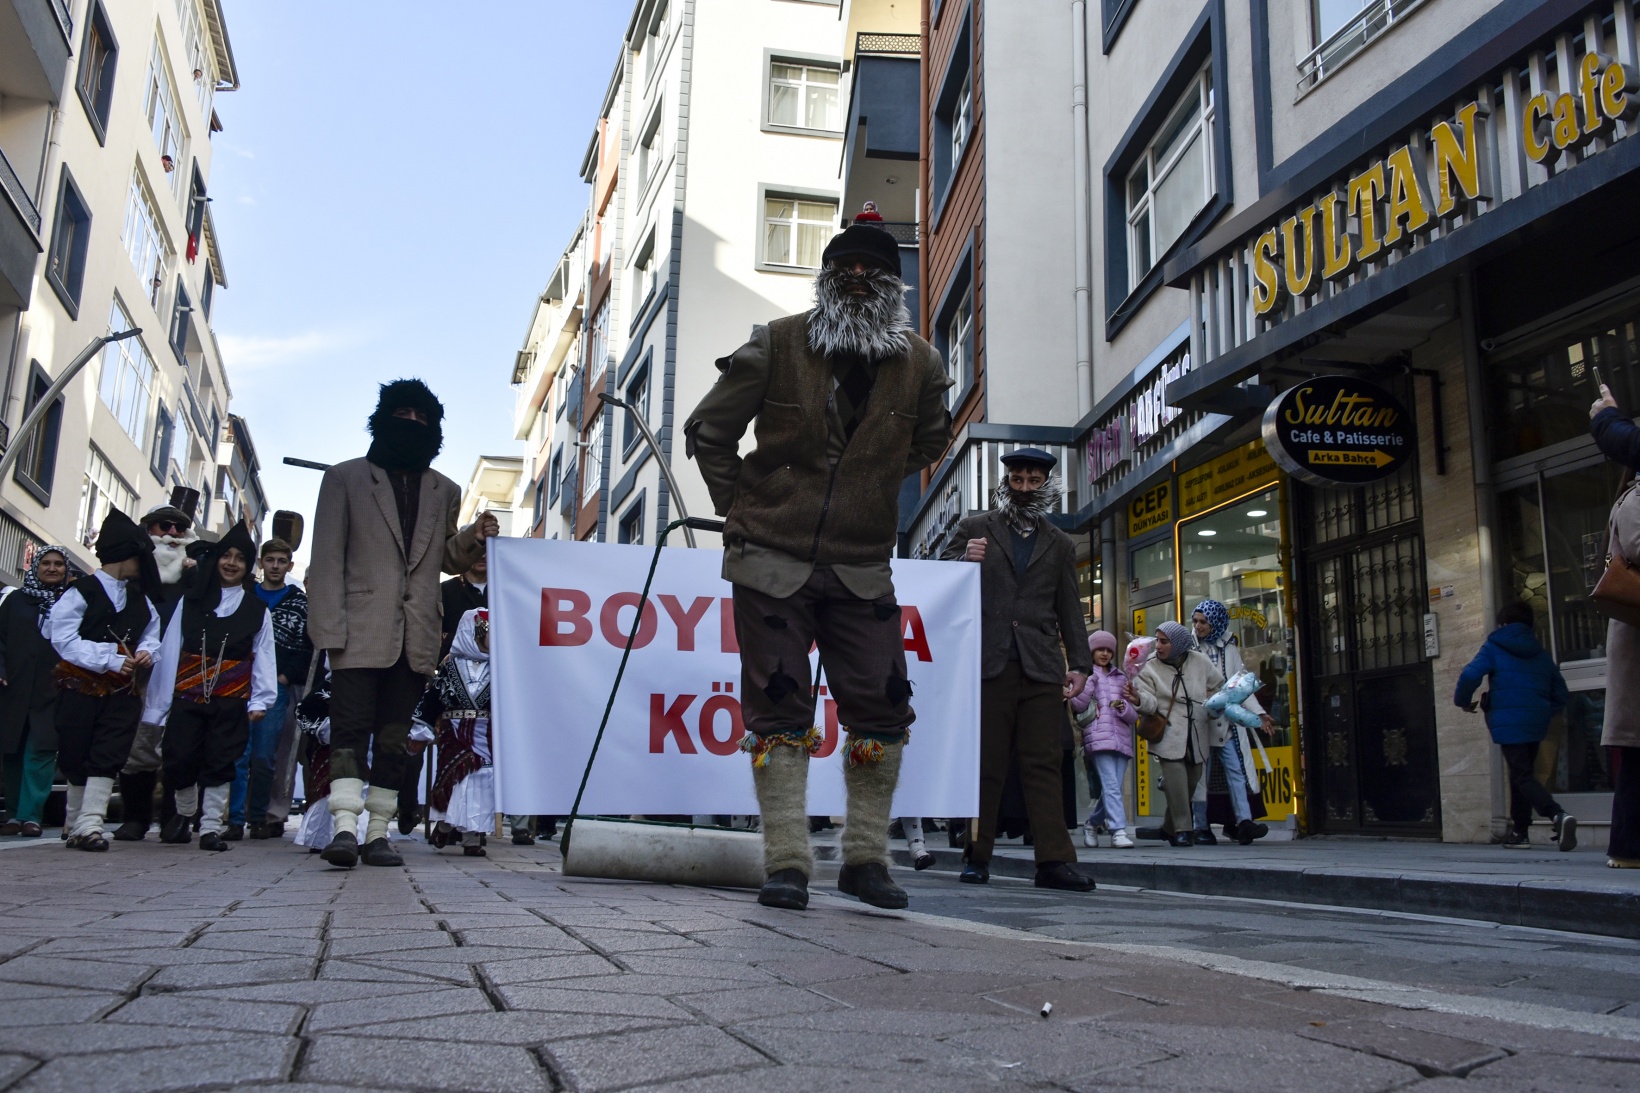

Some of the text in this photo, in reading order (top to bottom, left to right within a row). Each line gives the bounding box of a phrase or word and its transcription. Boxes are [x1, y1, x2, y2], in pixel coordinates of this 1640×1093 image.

[1253, 52, 1630, 318] SULTAN Cafe
[1285, 387, 1399, 427] Sultan
[1290, 429, 1404, 446] Cafe & Patisserie
[1313, 453, 1377, 465] Arka Bahçe
[1133, 486, 1168, 518] CEP
[1228, 603, 1268, 631] ÜNYASI
